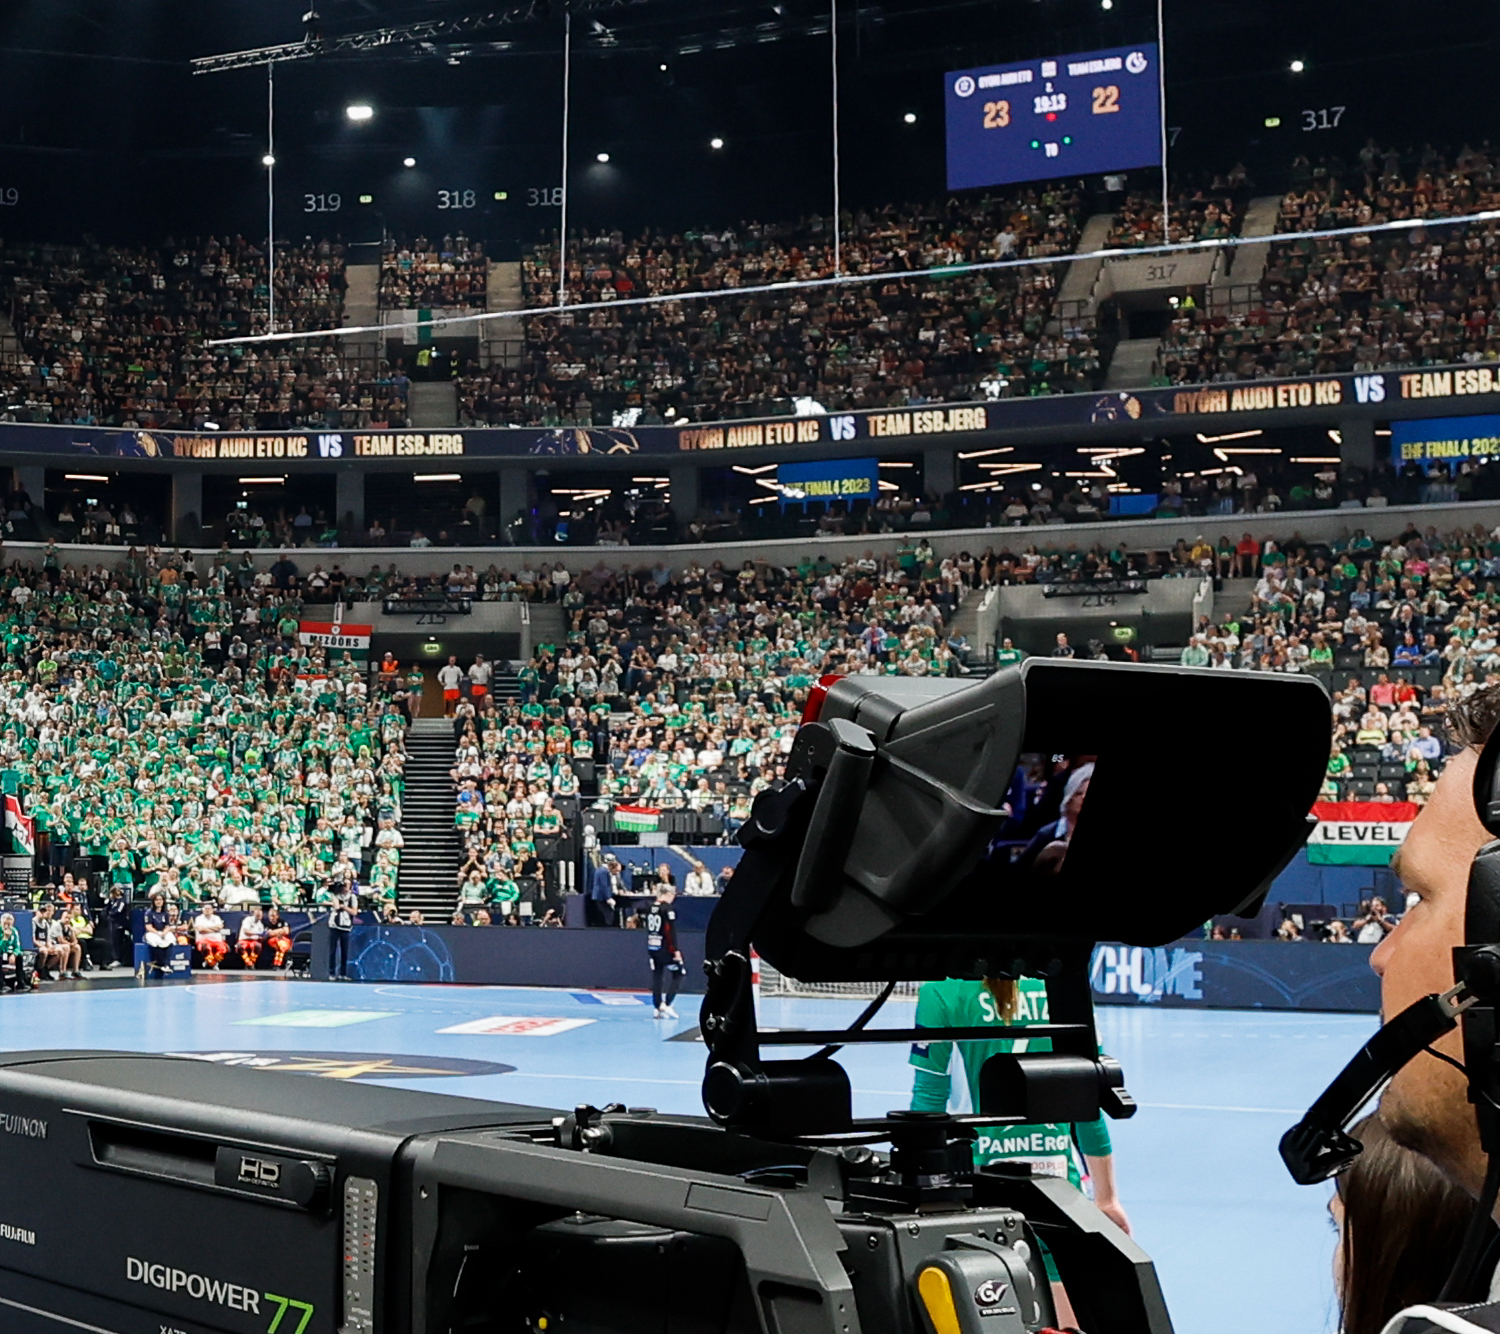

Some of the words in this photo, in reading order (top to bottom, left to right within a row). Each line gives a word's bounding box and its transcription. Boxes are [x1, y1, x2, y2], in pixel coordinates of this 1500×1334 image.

[1092, 85, 1120, 114] 22
[983, 100, 1011, 129] 23
[1302, 106, 1346, 131] 317
[304, 193, 341, 212] 319
[437, 189, 476, 209] 318
[527, 187, 564, 206] 318
[1146, 263, 1177, 281] 317
[1231, 387, 1274, 411] AUDI
[1277, 383, 1311, 408] ETO
[1315, 380, 1341, 405] KC
[1354, 375, 1385, 403] VS
[1400, 372, 1452, 398] TEAM
[727, 425, 765, 447] AUDI
[765, 423, 795, 445] ETO
[797, 420, 819, 443] KC
[829, 416, 856, 441] VS
[867, 413, 911, 437] TEAM
[913, 407, 986, 434] ESBJERG
[219, 437, 254, 457] AUDI
[256, 437, 285, 457] ETO
[287, 436, 307, 457] KC
[319, 435, 342, 457] VS
[353, 435, 394, 456] TEAM
[396, 434, 463, 456] ESBJERG
[1426, 440, 1469, 458] FINAL4
[805, 479, 840, 496] FINAL4
[841, 477, 871, 494] 2023
[647, 914, 661, 932] 89
[241, 1156, 279, 1181] HD
[126, 1257, 260, 1315] DIGIPOWER
